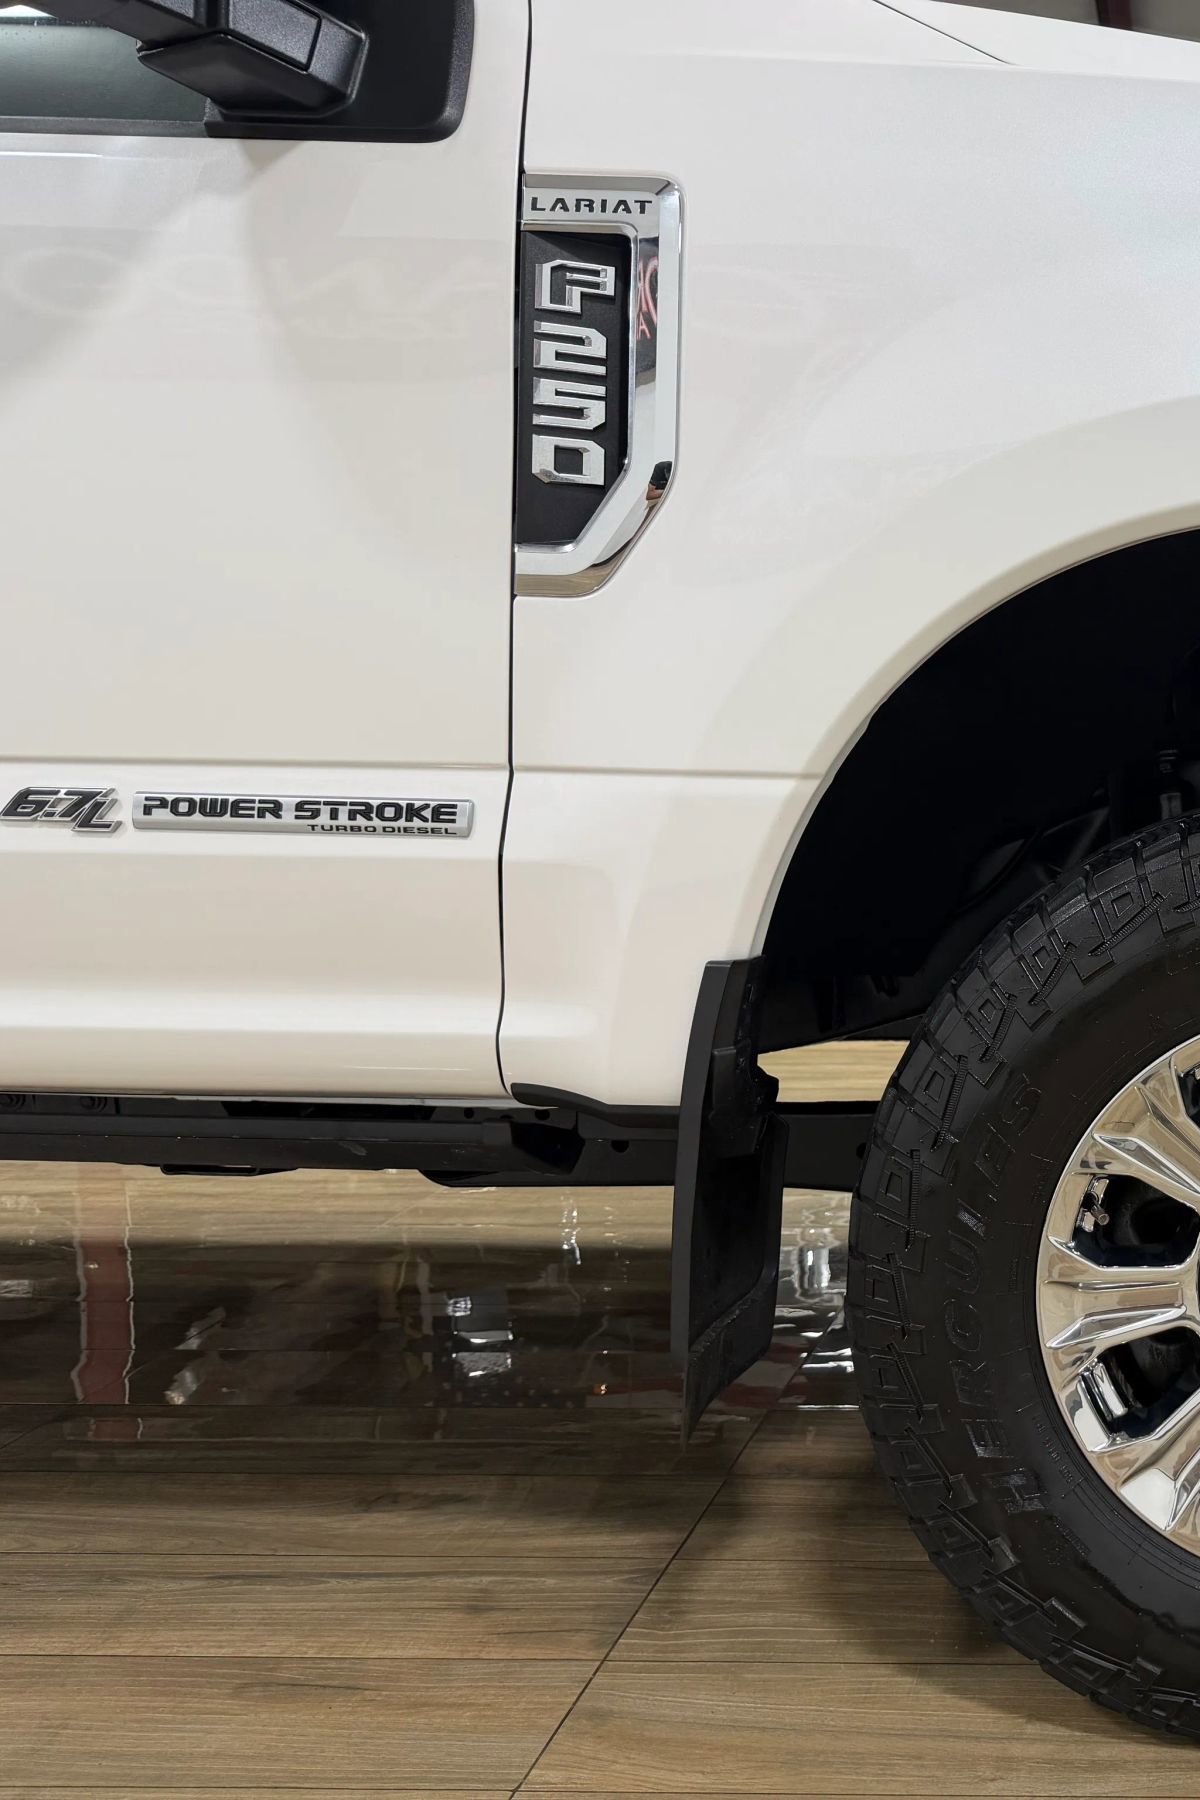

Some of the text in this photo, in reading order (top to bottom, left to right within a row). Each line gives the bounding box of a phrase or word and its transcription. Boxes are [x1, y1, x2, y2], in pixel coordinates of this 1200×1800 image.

[530, 197, 653, 215] LARIAT
[532, 259, 617, 486] F250
[143, 796, 458, 824] POWER STROKE
[307, 824, 457, 836] TURBO DIESEL
